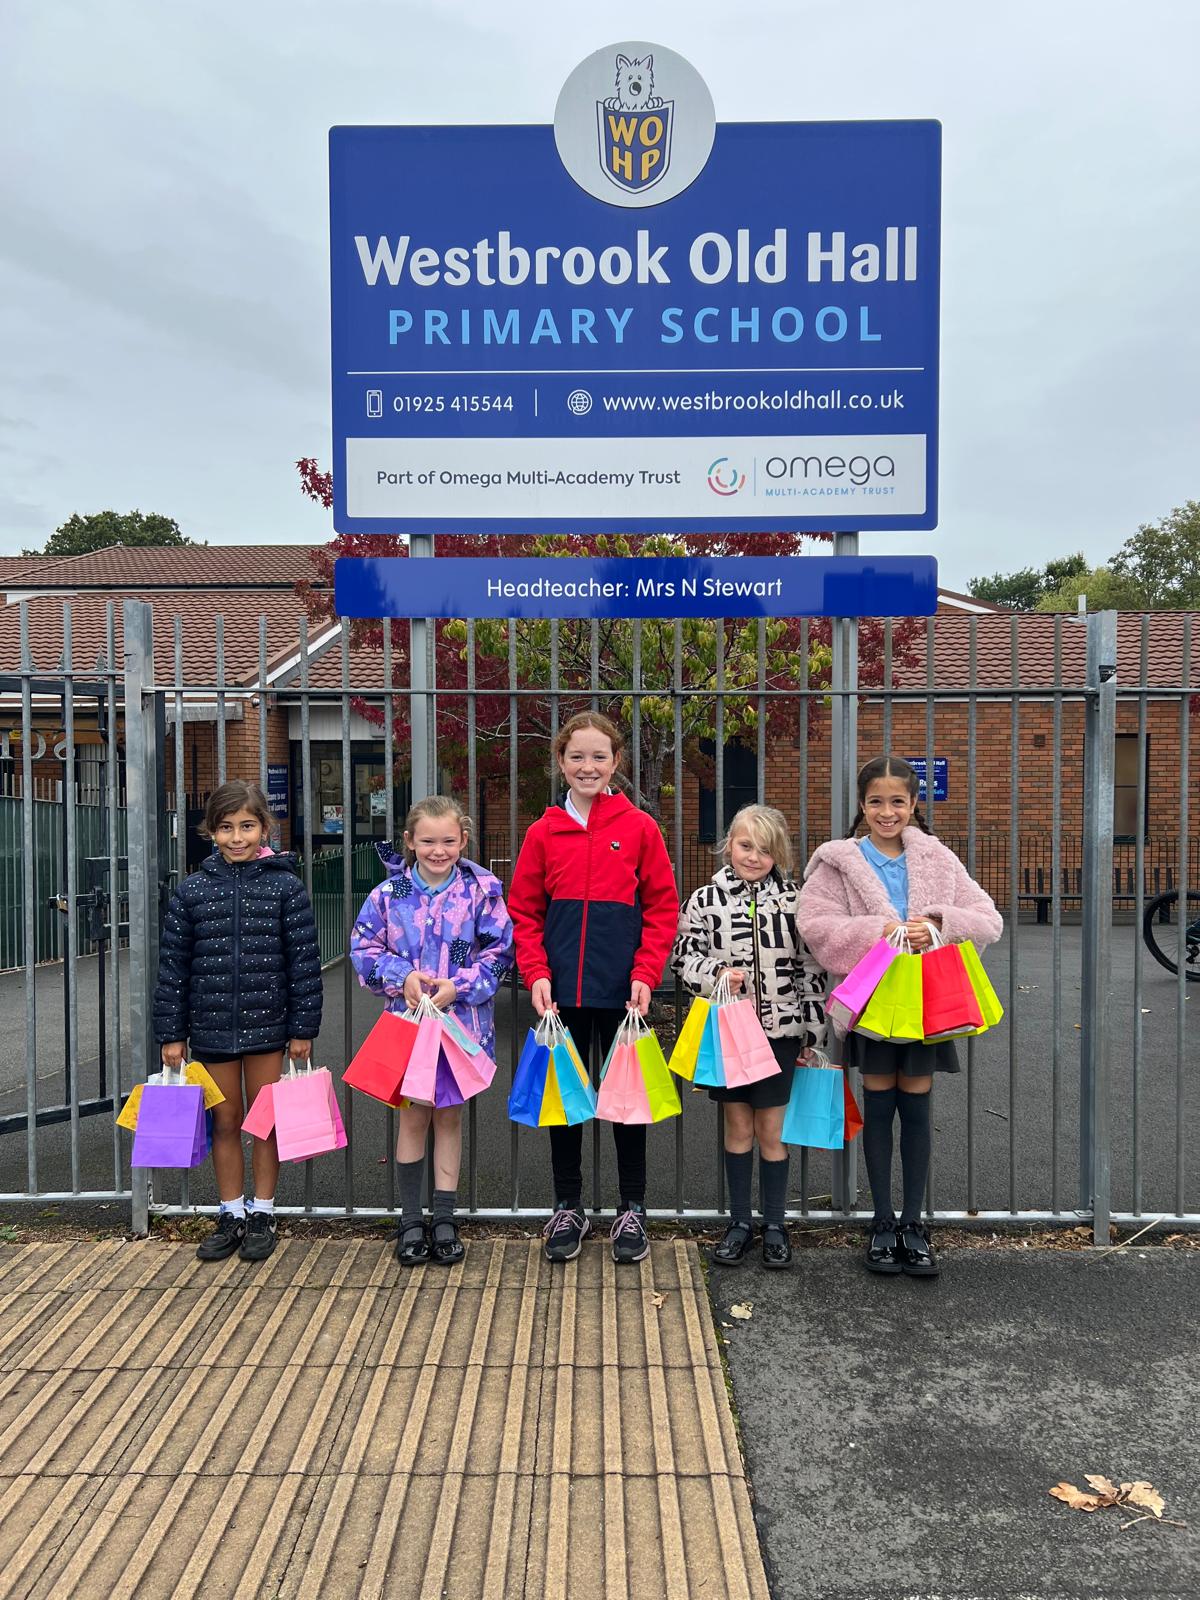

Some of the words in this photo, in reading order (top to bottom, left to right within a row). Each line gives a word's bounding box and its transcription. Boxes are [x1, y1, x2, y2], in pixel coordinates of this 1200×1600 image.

[608, 115, 664, 147] WO
[612, 146, 660, 181] HP
[354, 230, 671, 287] Westbrook
[689, 228, 787, 285] Old
[807, 226, 918, 283] Hall
[389, 307, 634, 345] PRIMARY
[660, 305, 882, 344] SCHOOL
[393, 396, 445, 412] 01925
[450, 395, 514, 412] 415544
[602, 389, 904, 412] www.westbrookoldhall.co.uk
[377, 470, 413, 485] Part
[417, 470, 436, 485] of
[439, 470, 502, 488] Omega
[507, 470, 635, 488] Multi-Academy
[638, 470, 681, 485] Trust
[765, 455, 895, 485] omega
[765, 487, 856, 496] MULTI-ACADEMY
[862, 486, 895, 495] TRUST
[487, 577, 629, 597] Headteacher:
[636, 578, 675, 597] Mrs
[682, 578, 697, 596] N
[703, 578, 783, 597] Stewart
